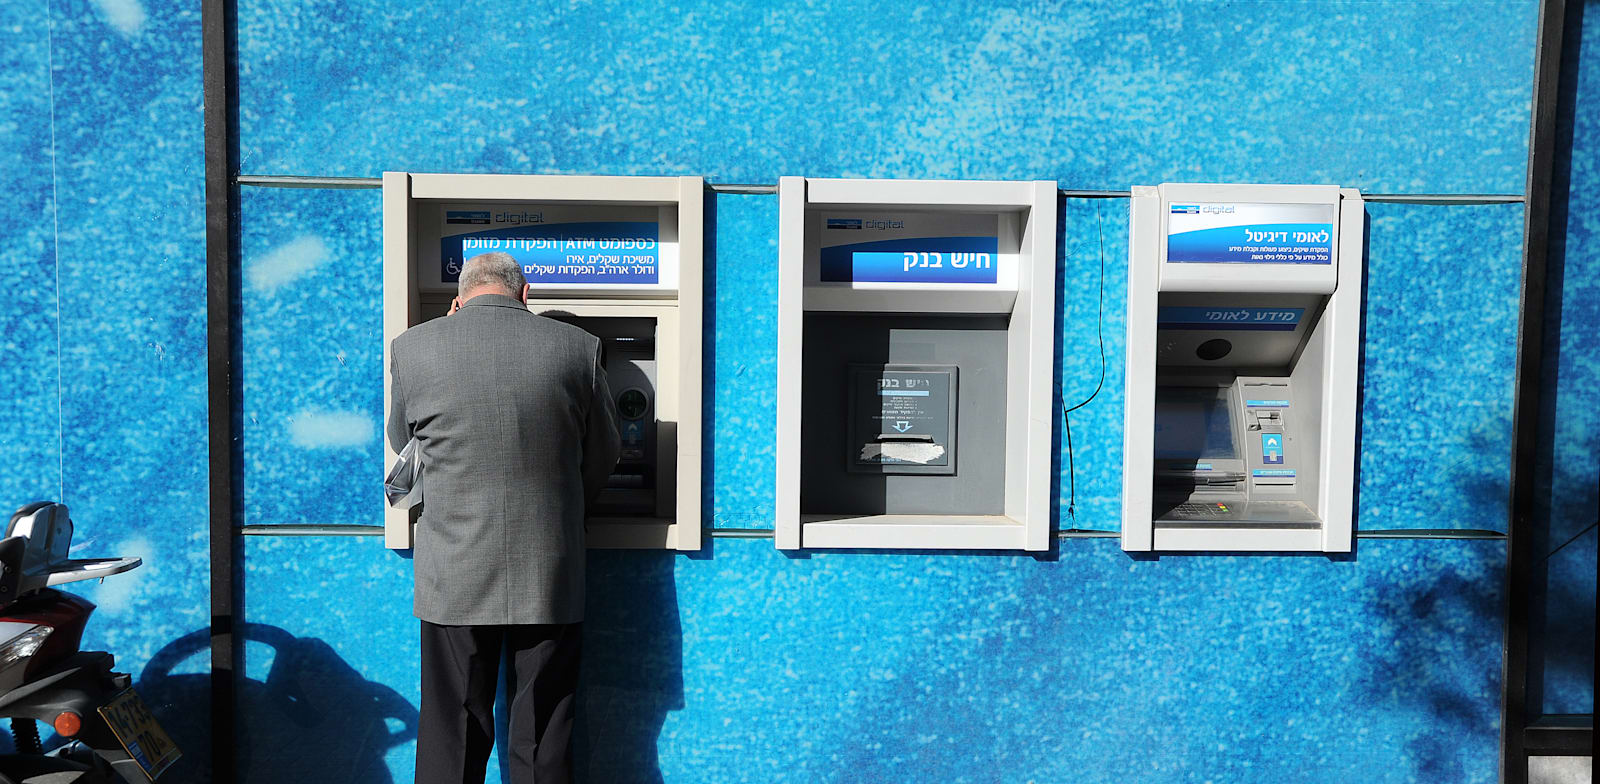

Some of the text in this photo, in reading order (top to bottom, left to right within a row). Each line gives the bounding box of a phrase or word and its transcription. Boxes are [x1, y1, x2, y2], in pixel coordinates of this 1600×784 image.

[1203, 205, 1235, 215] digital
[495, 211, 544, 225] digital
[865, 219, 905, 231] digital
[1244, 229, 1330, 243] לאומי דיגיטל
[463, 236, 656, 252] כספומט ATM הפקדת מזומן
[566, 253, 655, 266] משיכת שקלים, אירו
[903, 251, 991, 272] חיש בנק
[523, 262, 556, 275] שקלים
[557, 264, 596, 276] הפקדות
[633, 264, 655, 274] ודולר
[1205, 309, 1296, 321] מידע לאומי
